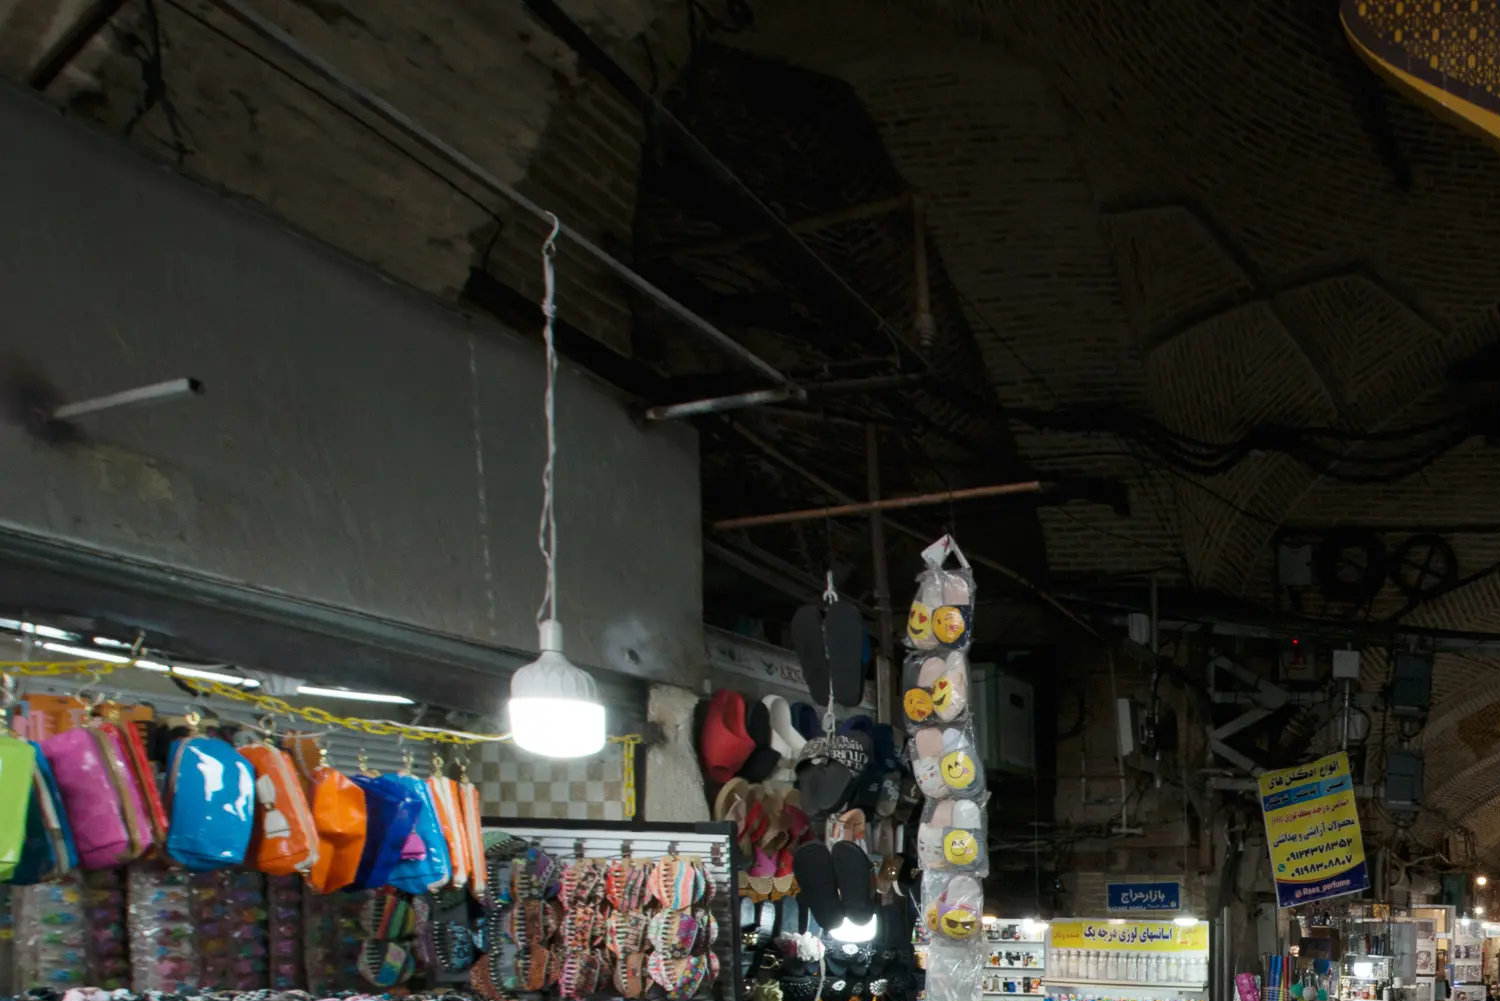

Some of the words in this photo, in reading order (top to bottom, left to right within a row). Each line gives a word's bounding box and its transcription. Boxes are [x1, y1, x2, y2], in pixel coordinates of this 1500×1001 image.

[1319, 760, 1339, 777] انواع
[1268, 775, 1284, 790] های
[1083, 925, 1096, 941] یک
[1098, 927, 1117, 942] درجه
[1139, 926, 1173, 944] اسانسهای
